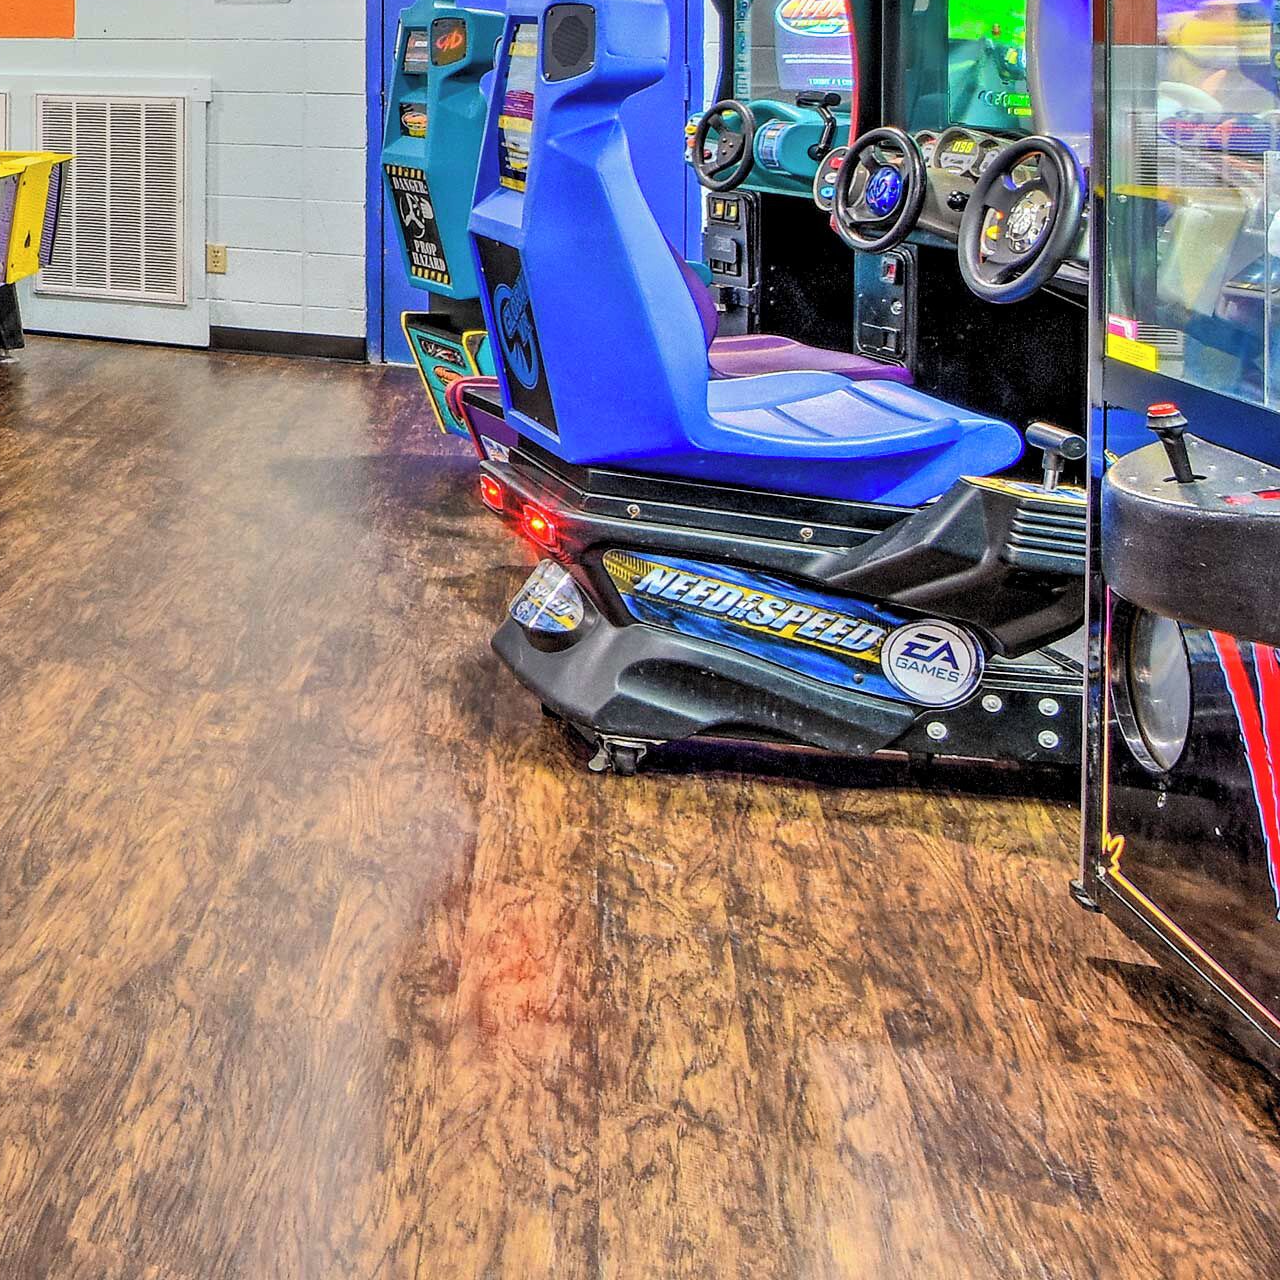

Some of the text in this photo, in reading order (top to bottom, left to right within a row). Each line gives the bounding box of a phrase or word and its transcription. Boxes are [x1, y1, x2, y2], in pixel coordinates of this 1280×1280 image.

[413, 239, 437, 255] PROP
[411, 251, 447, 272] HAZARD
[634, 568, 740, 615] NEED
[748, 598, 889, 653] SPEED
[900, 632, 960, 671] EA
[895, 655, 965, 683] GAMES
